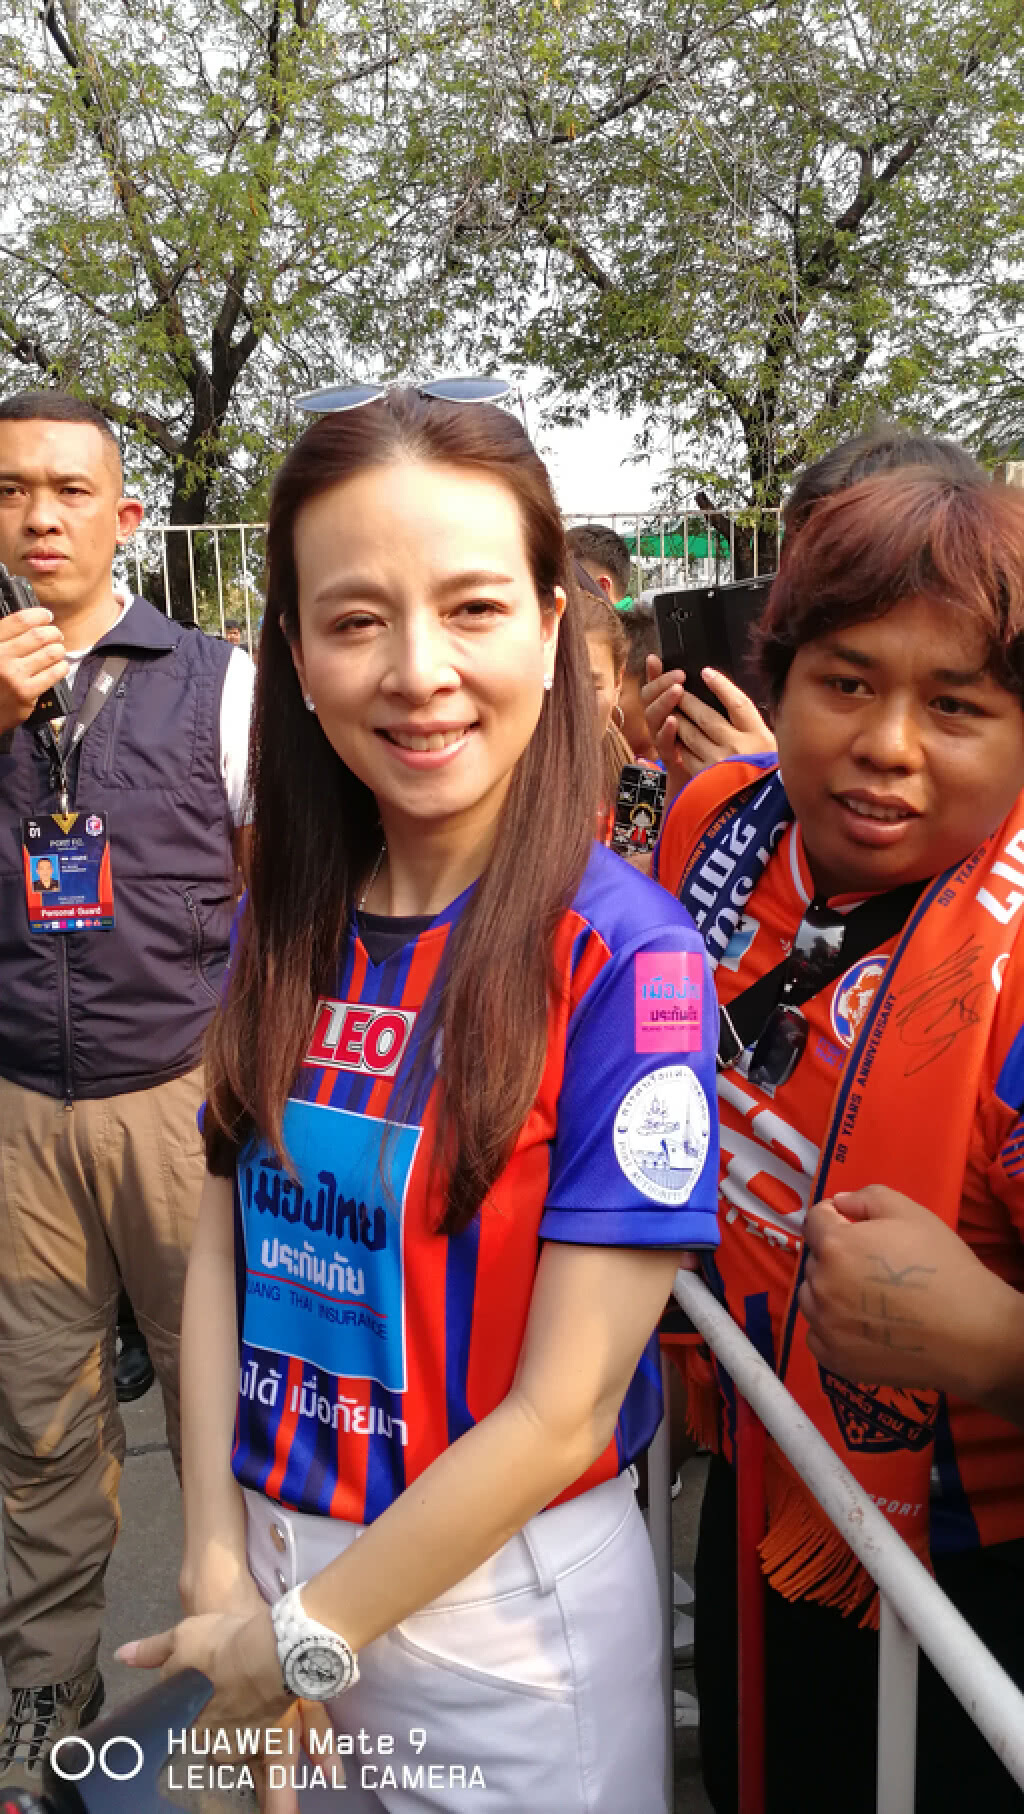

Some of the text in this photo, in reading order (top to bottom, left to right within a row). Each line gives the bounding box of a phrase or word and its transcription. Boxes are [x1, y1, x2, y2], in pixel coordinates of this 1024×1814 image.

[40, 905, 102, 917] Personal Guard
[303, 1002, 409, 1073] LEO
[260, 1237, 366, 1296] ประกันภัย
[289, 1288, 313, 1313] THAI
[316, 1303, 389, 1341] INSURANCE
